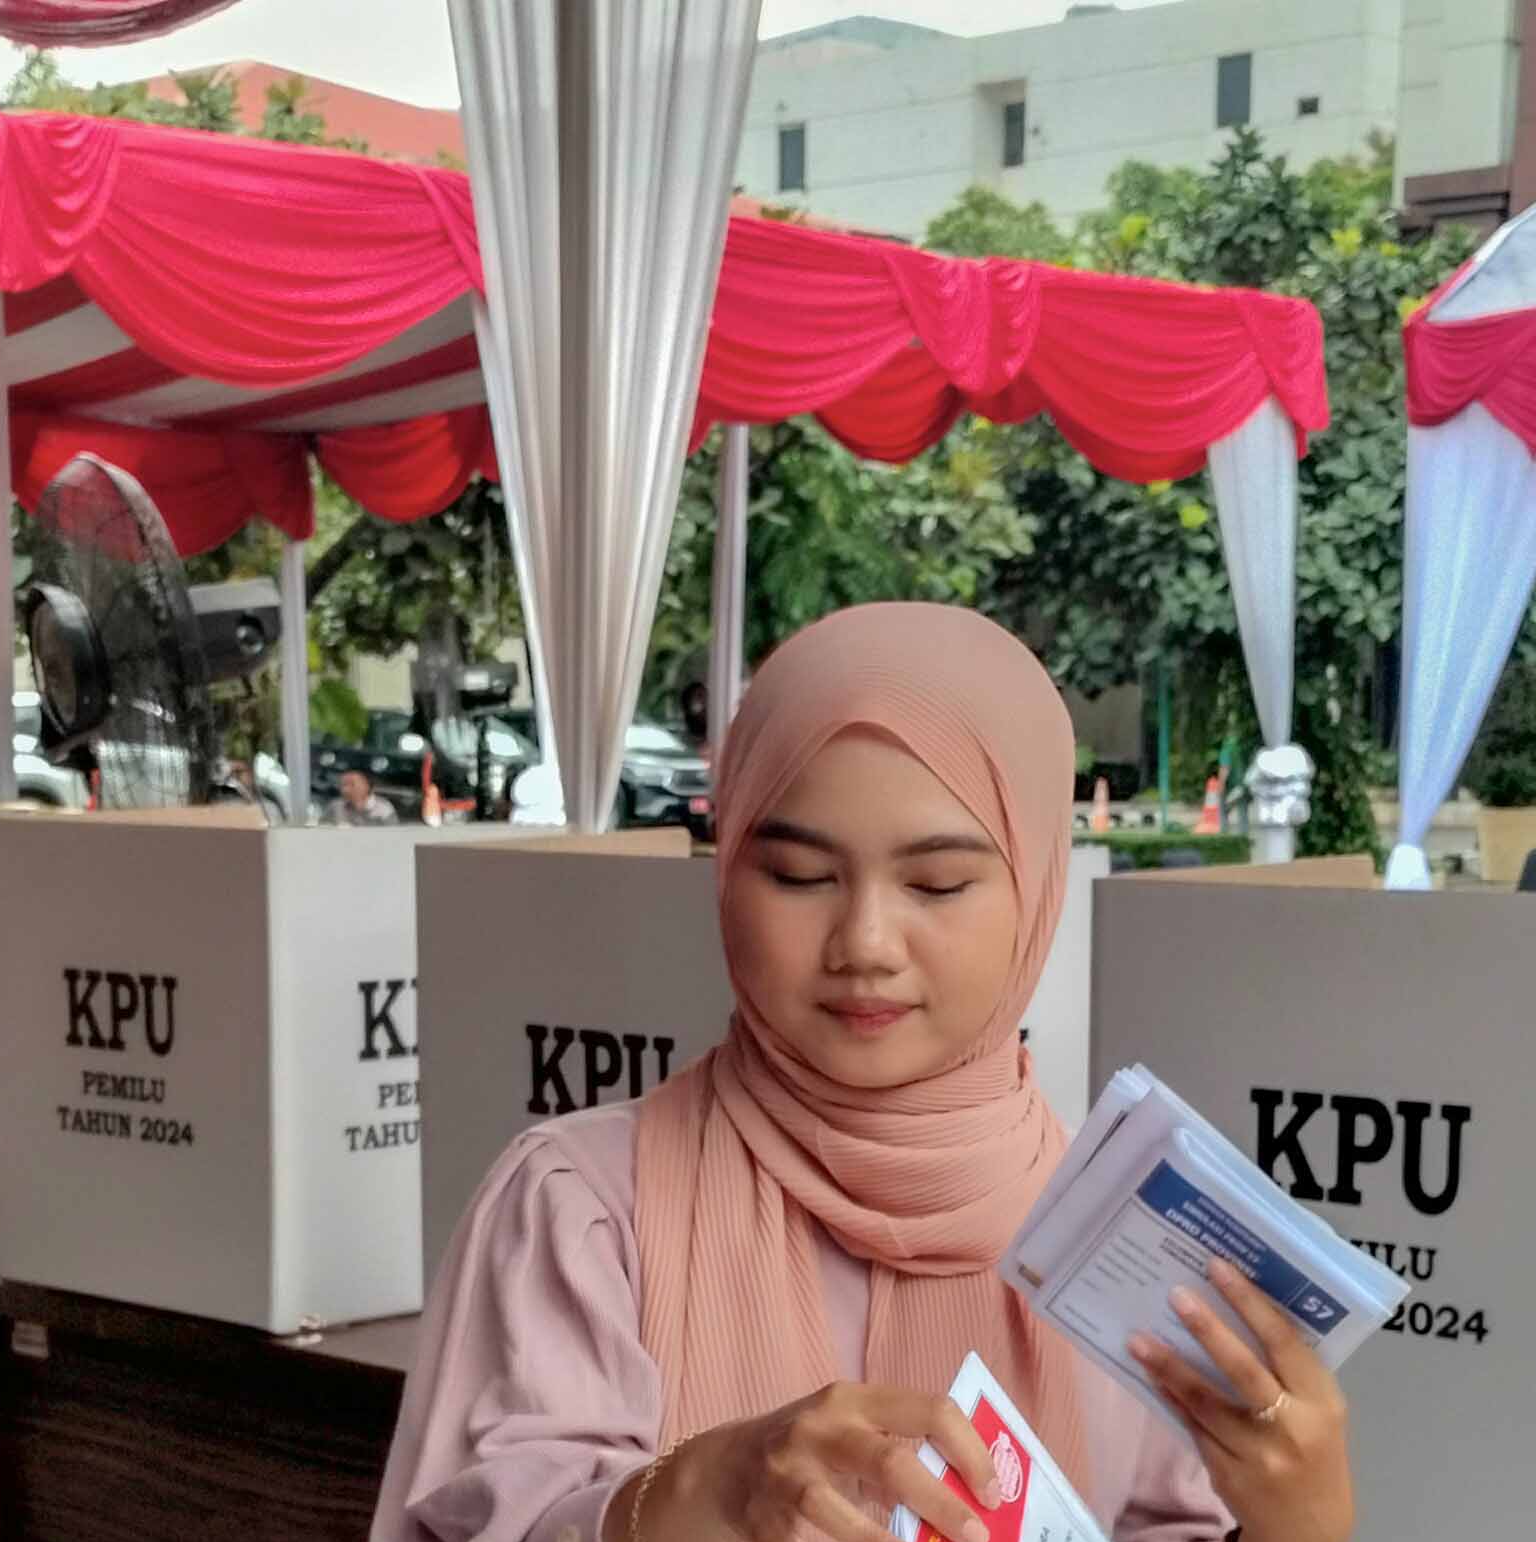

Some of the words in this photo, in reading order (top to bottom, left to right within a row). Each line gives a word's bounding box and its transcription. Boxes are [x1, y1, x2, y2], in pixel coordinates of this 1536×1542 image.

[63, 967, 178, 1057] KPU
[82, 1070, 166, 1105] PEMILU
[56, 1105, 133, 1140] TAHUN
[139, 1115, 196, 1147] 2024
[345, 1120, 421, 1151] TAHU
[1249, 1087, 1472, 1216] KPU
[1302, 1297, 1335, 1320] 57
[1380, 1302, 1489, 1343] 2024
